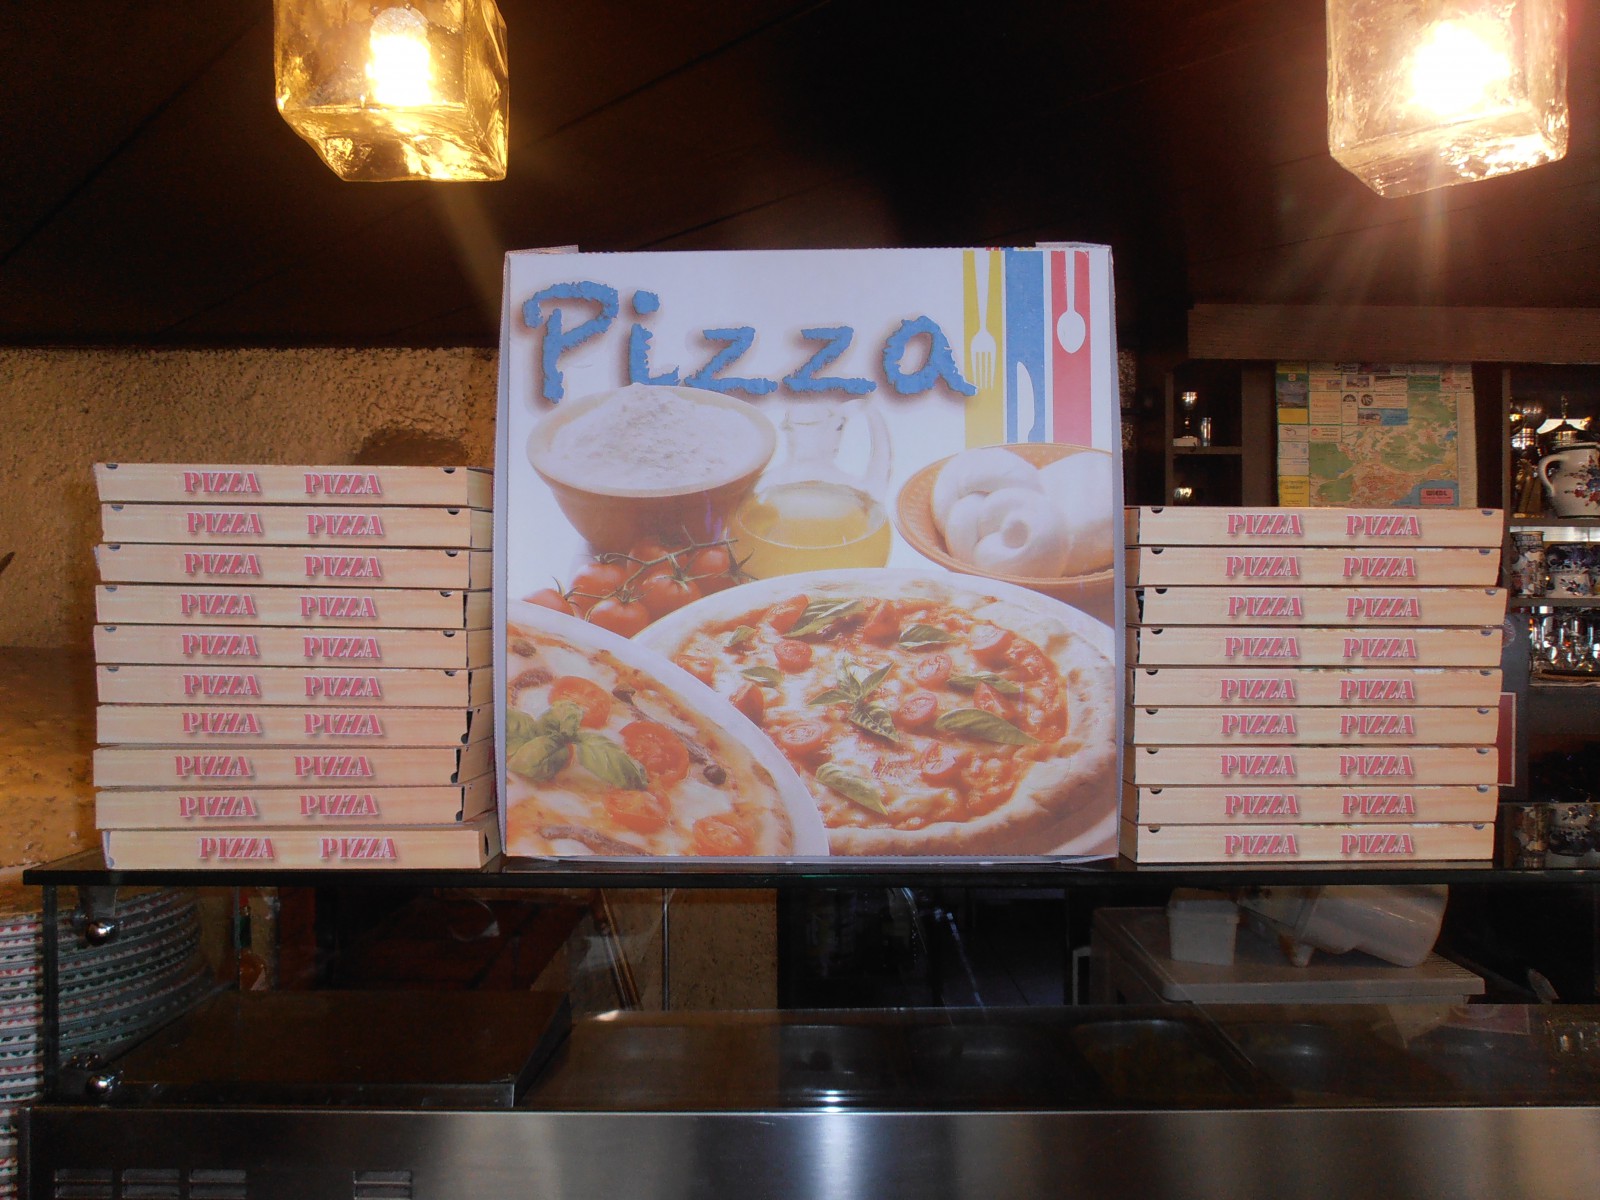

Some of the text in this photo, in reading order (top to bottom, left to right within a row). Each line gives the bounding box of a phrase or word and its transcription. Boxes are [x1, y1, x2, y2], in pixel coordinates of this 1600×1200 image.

[522, 280, 978, 404] Pizza
[184, 472, 380, 496] PIZZA PIZZA
[187, 512, 383, 537] PIZZA PIZZA
[1227, 514, 1420, 537] PIZZA PIZZA
[185, 553, 381, 579] PIZZA PIZZA
[1226, 556, 1415, 578] PIZZA PIZZA
[181, 593, 376, 619] PIZZA PIZZA
[1229, 596, 1420, 619] PIZZA PIZZA
[182, 634, 380, 660] PIZZA PIZZA
[1226, 637, 1416, 659] PIZZA PIZZA
[184, 675, 381, 699] PIZZA PIZZA
[1221, 679, 1415, 702] PIZZA PIZZA
[183, 712, 382, 736] PIZZA PIZZA
[1222, 715, 1414, 737] PIZZA PIZZA
[175, 755, 371, 779] PIZZA PIZZA
[1221, 755, 1414, 778] PIZZA PIZZA
[180, 794, 377, 818] PIZZA PIZZA
[1225, 795, 1416, 817] PIZZA PIZZA
[201, 837, 398, 861] PIZZA PIZZA
[1225, 834, 1414, 856] PIZZA PIZZA
